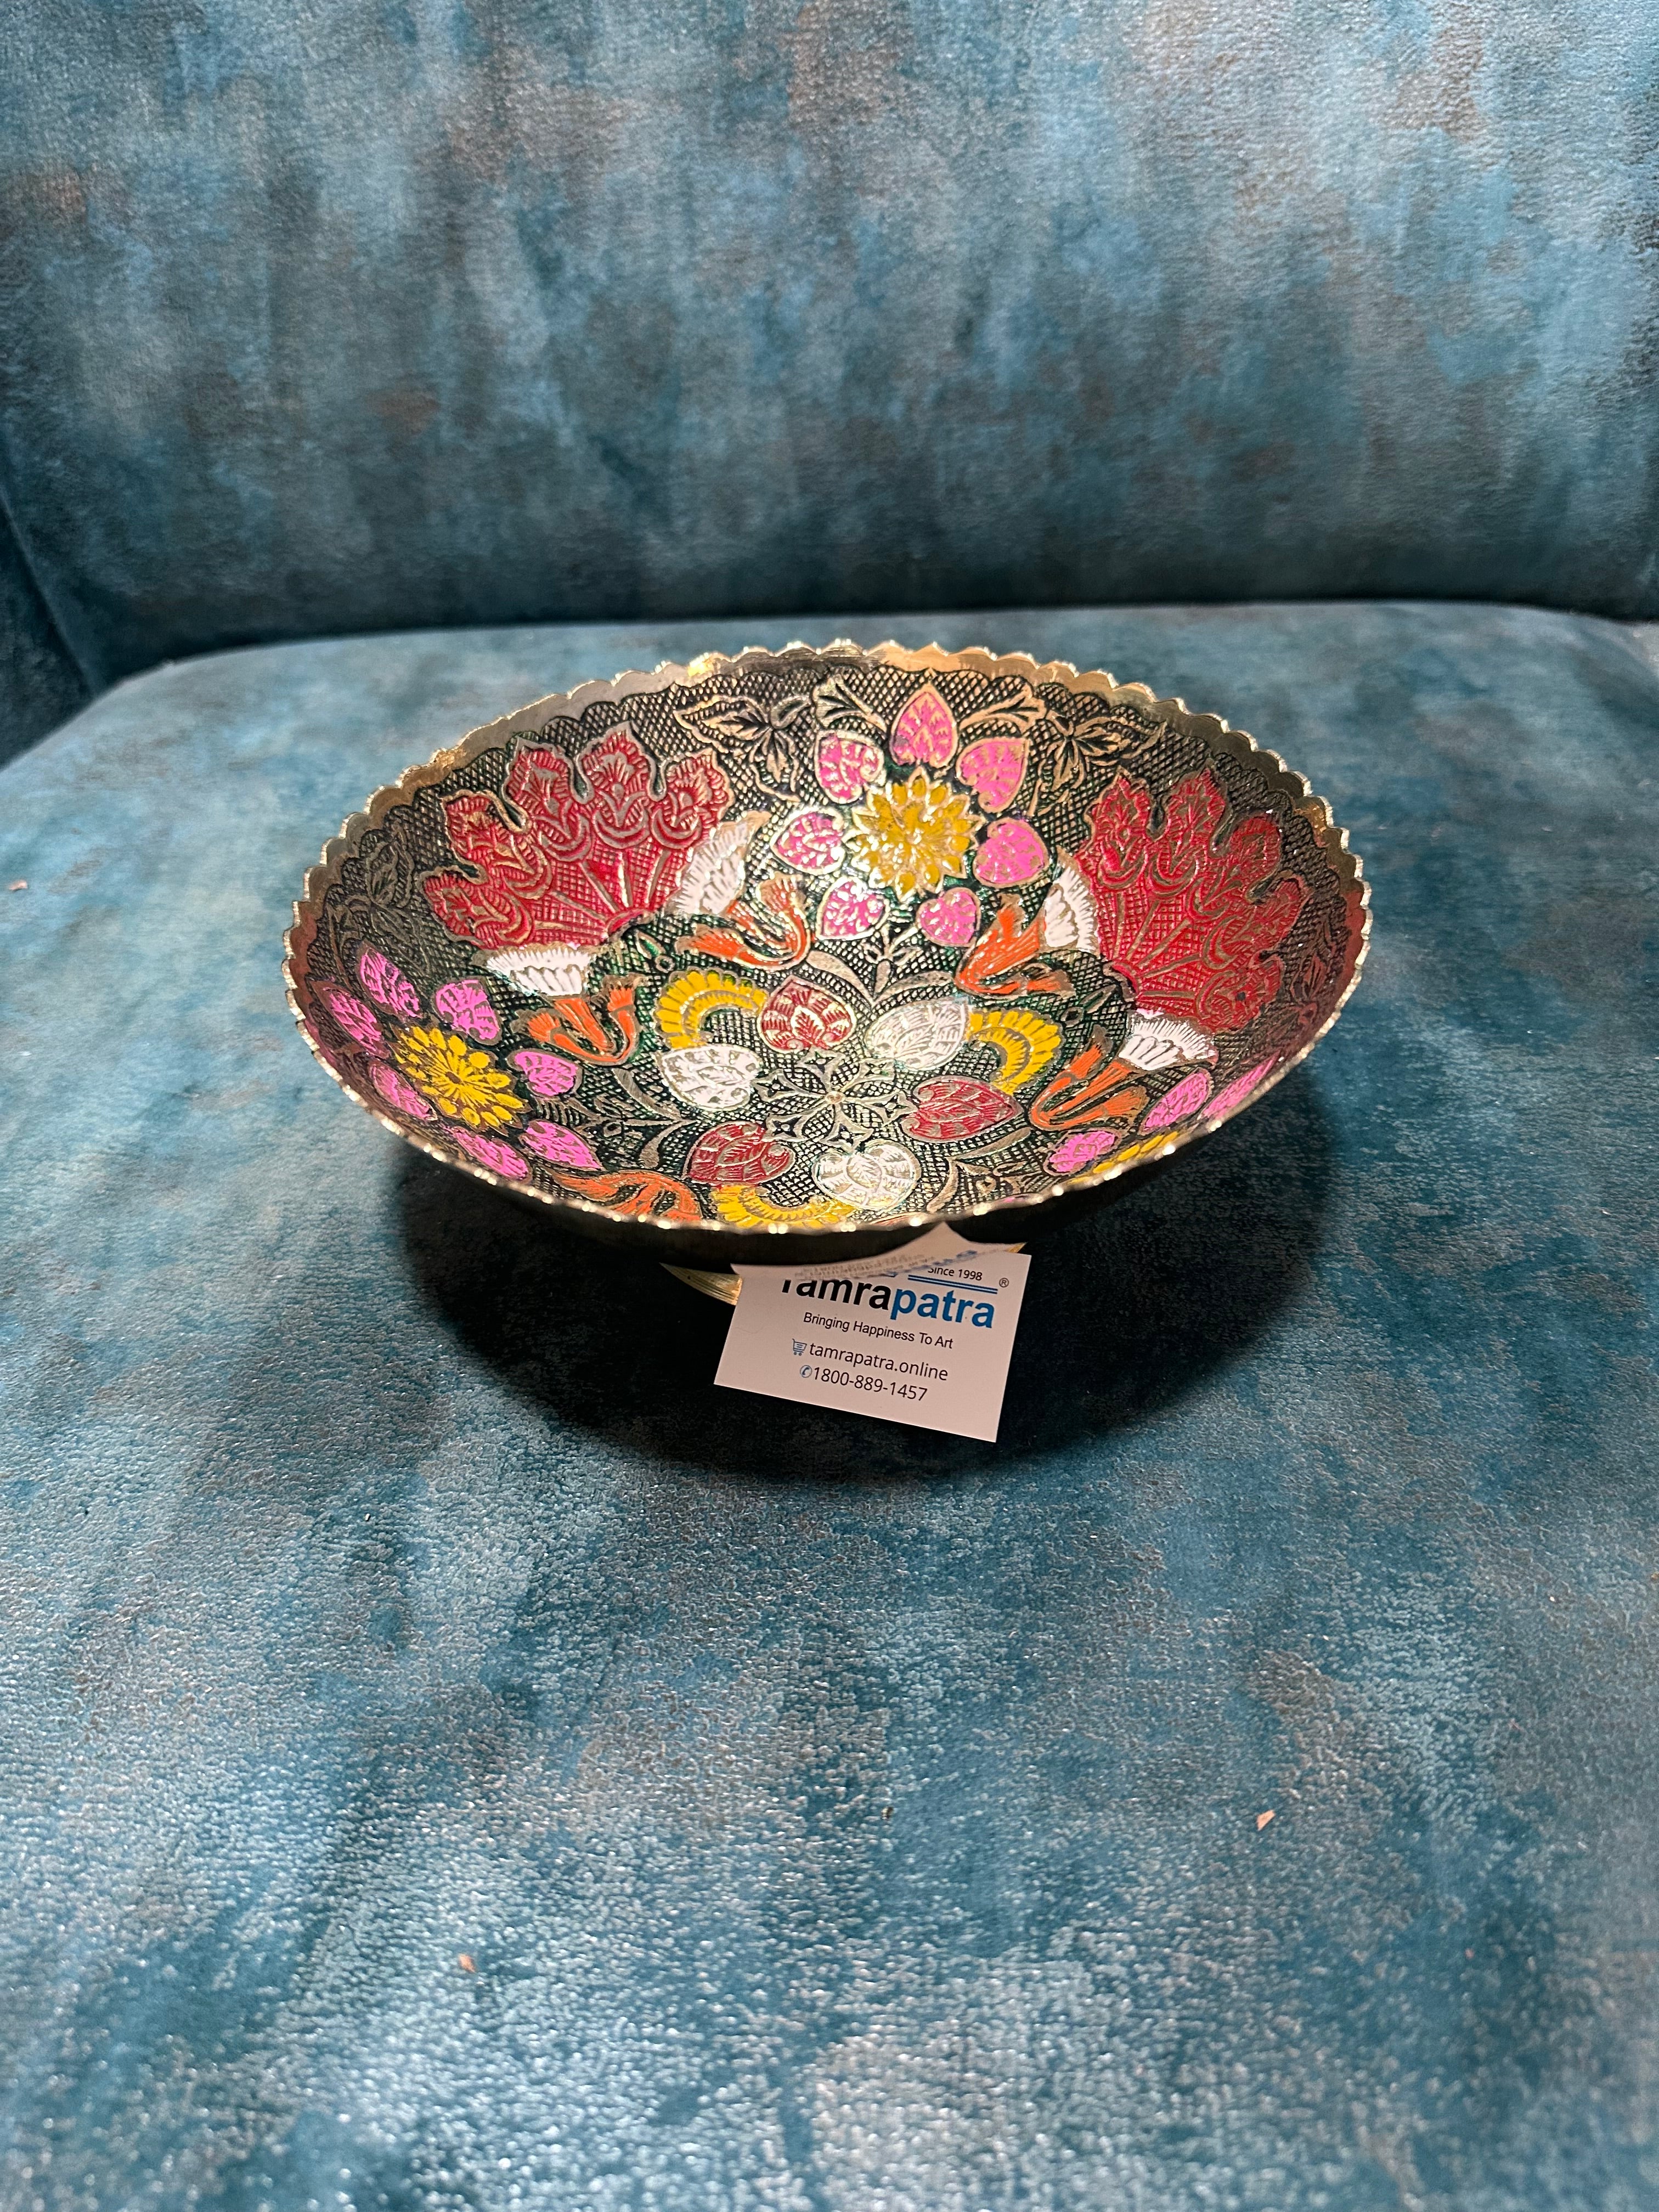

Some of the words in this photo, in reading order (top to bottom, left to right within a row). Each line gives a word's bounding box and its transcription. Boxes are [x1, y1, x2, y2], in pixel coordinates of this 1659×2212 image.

[958, 1269, 983, 1281] 1998
[804, 1312, 850, 1333] Bringing
[853, 1321, 915, 1342] Happiness
[919, 1332, 933, 1345] To
[934, 1336, 953, 1349] Art
[809, 1343, 948, 1381] tamrapatra.online
[814, 1367, 928, 1401] 1800-889-1457
